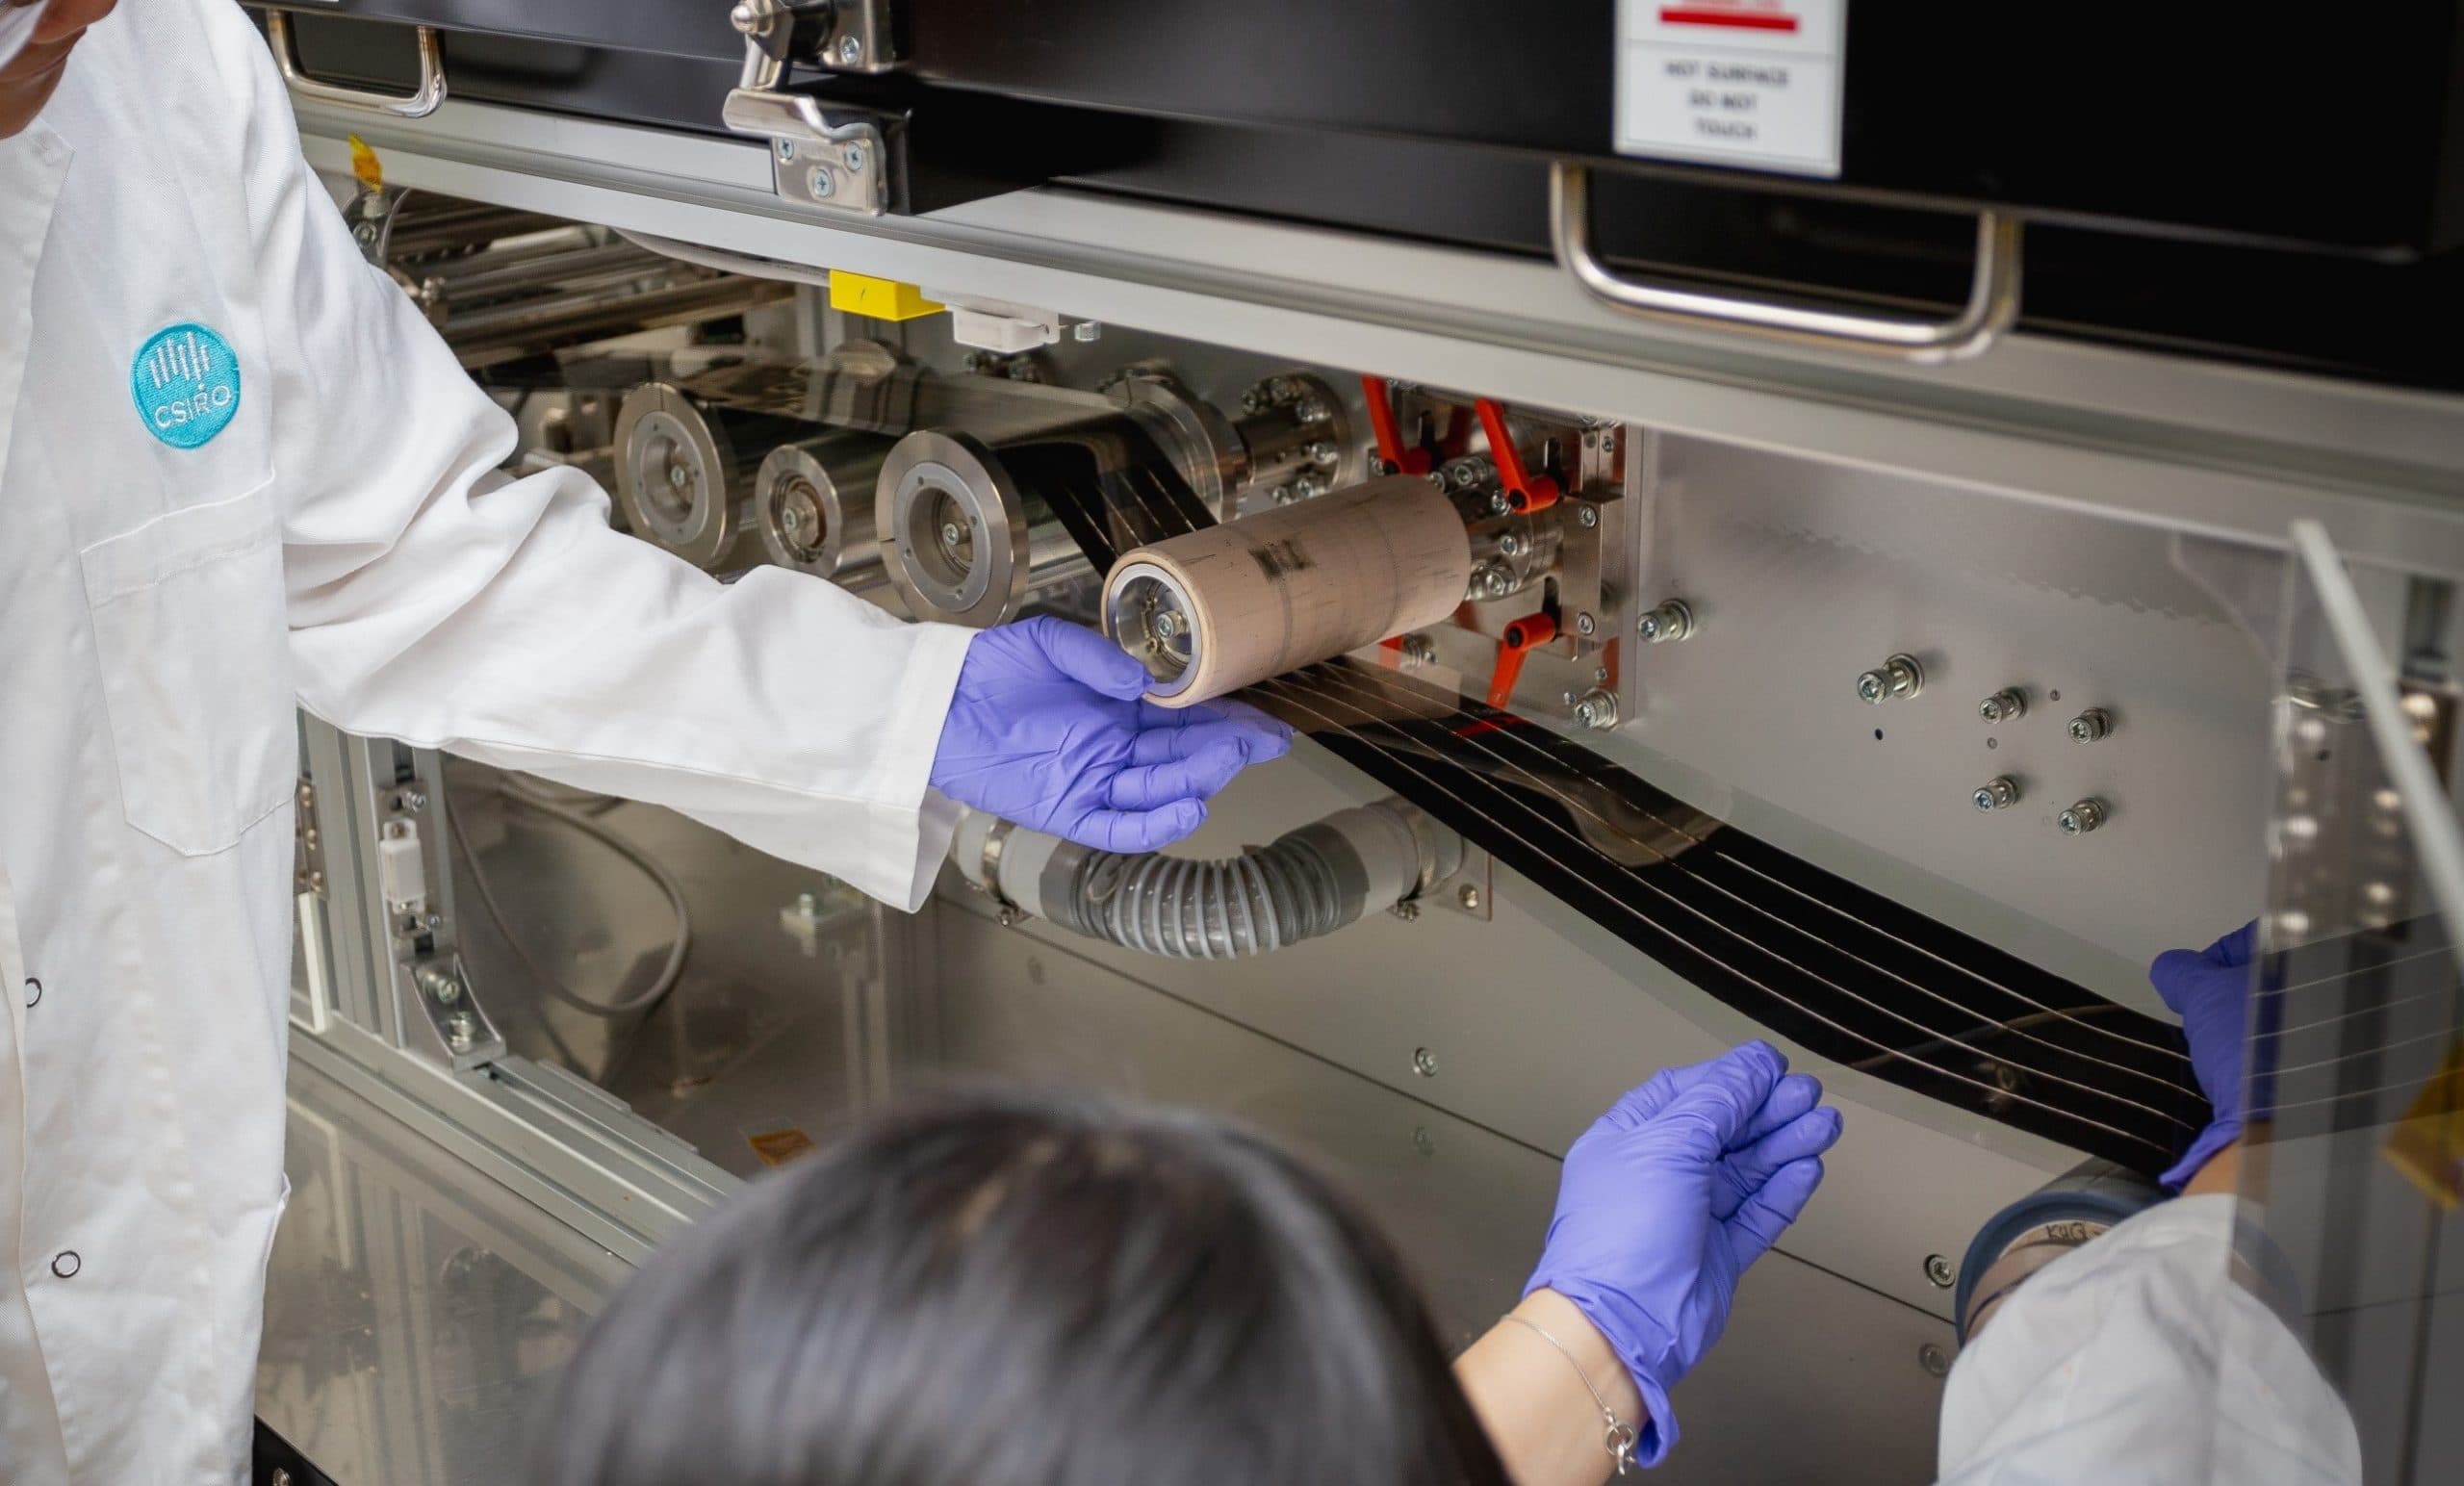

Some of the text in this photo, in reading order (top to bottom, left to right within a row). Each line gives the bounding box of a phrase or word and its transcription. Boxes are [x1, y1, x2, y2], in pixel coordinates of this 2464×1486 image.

[1665, 61, 1698, 77] HOT
[1689, 90, 1756, 110] DO NOT
[155, 385, 231, 427] CSIRO
